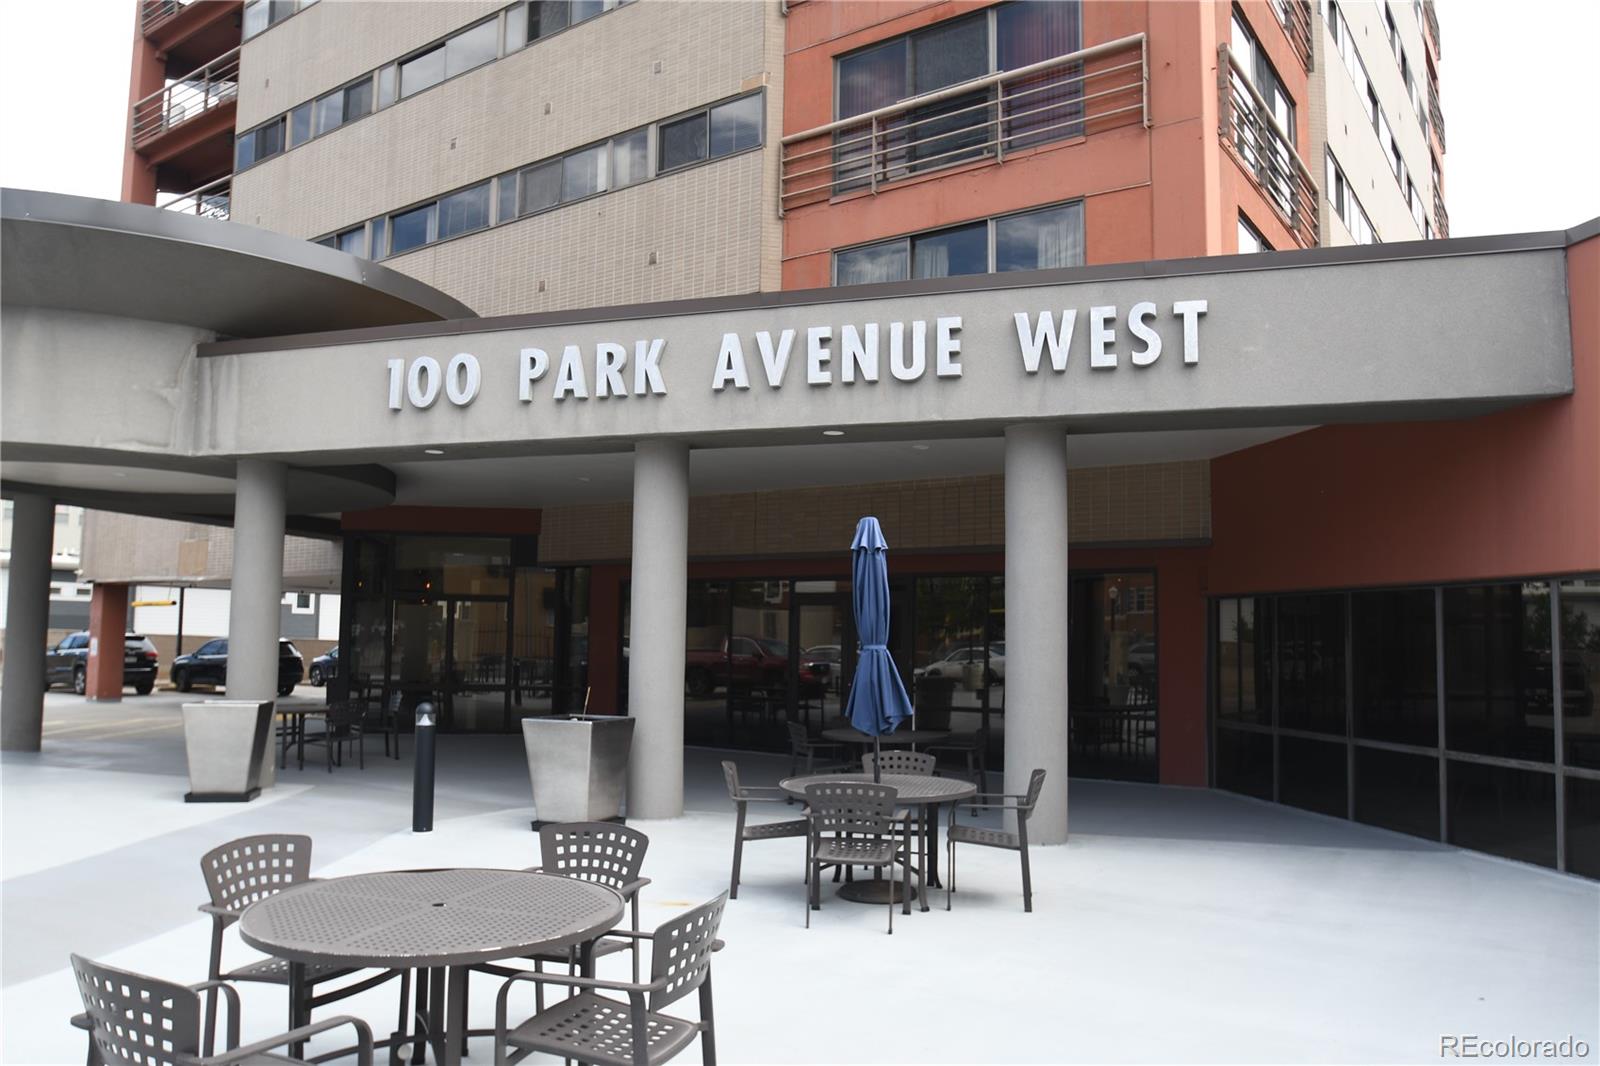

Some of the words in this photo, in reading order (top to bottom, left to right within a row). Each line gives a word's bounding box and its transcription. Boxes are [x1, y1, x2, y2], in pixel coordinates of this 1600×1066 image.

[387, 353, 482, 410] 100
[519, 338, 667, 404] PARK
[711, 316, 963, 392] AVENUE
[1014, 299, 1209, 373] WEST
